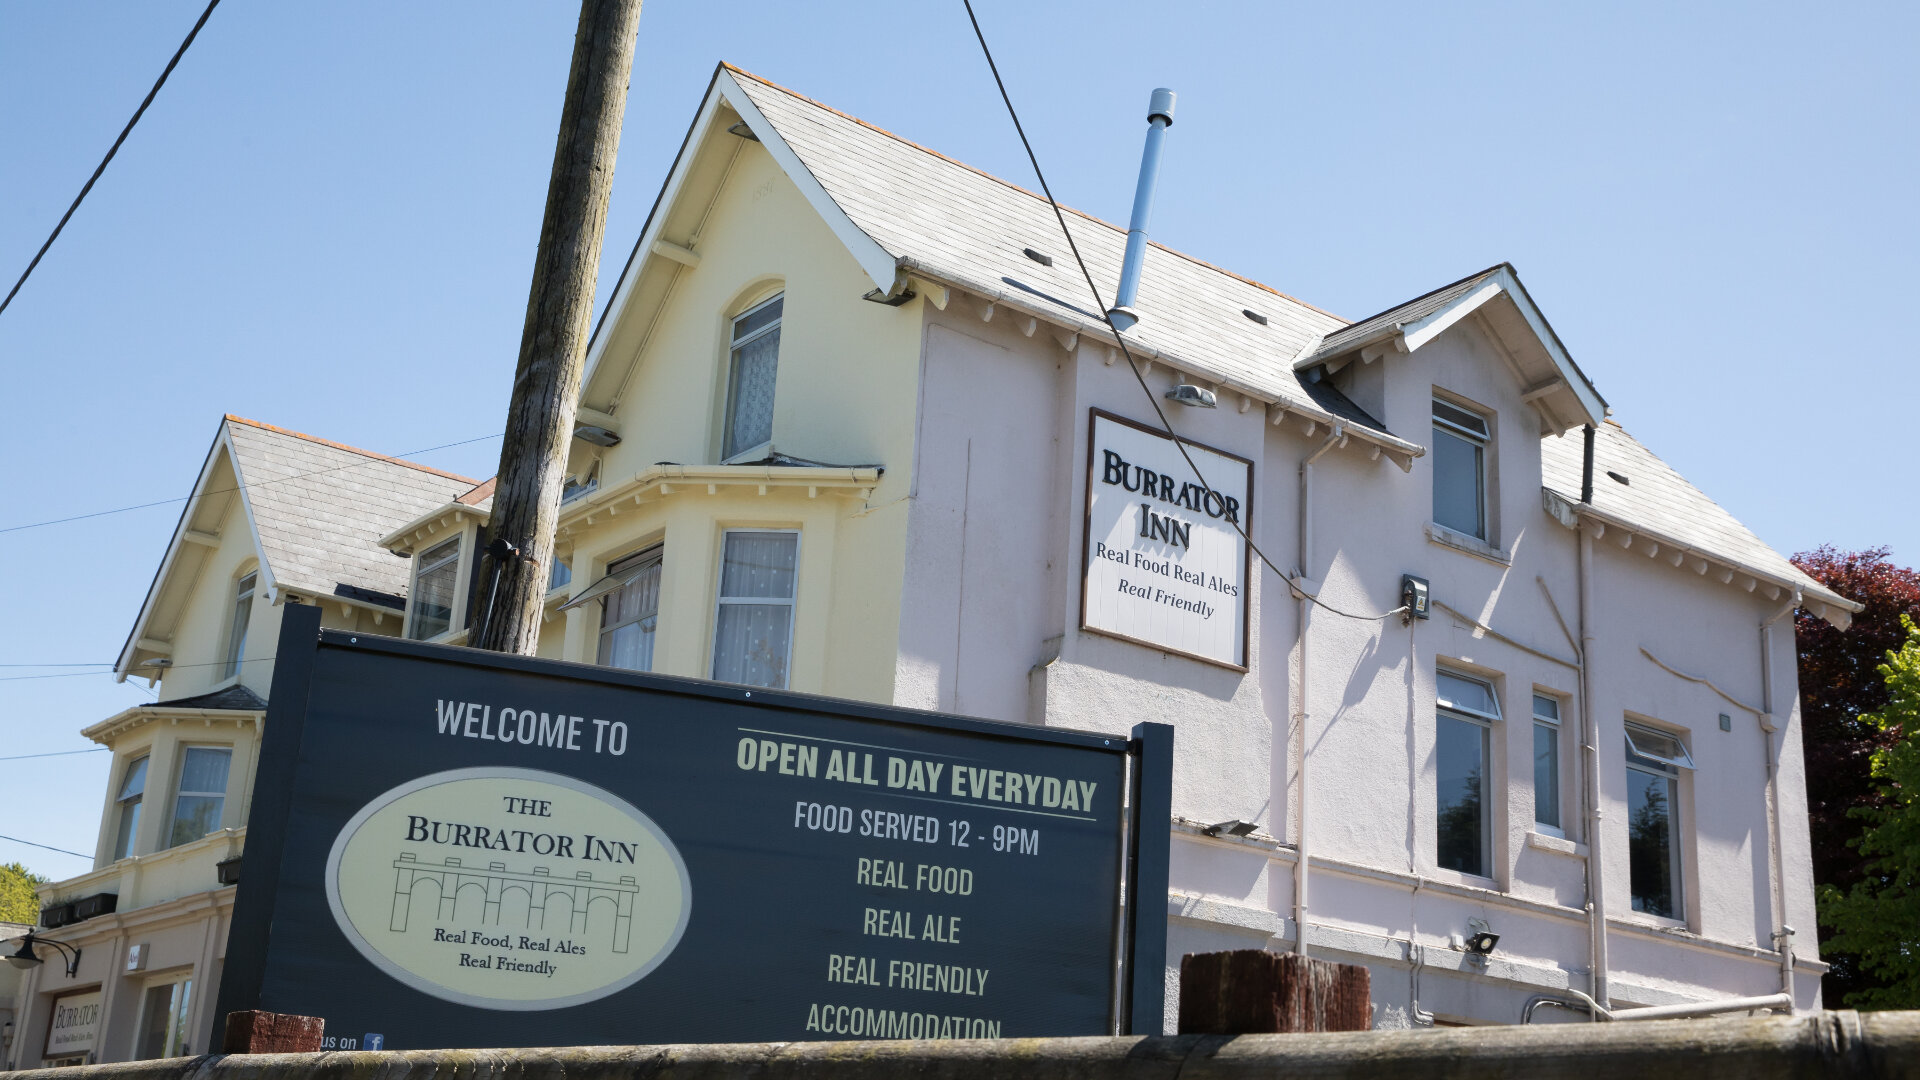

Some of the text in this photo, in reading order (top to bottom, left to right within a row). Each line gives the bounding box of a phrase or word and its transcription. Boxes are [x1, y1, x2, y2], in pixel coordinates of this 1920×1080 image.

[1102, 449, 1240, 524] BURRATOR
[1140, 503, 1191, 551] INN
[1097, 541, 1238, 597] Real Food Real Ales
[1118, 578, 1215, 620] Real Friendly
[437, 699, 628, 756] WELCOME TO
[736, 737, 1098, 812] OPEN ALL DAY EVERYDAY
[503, 796, 552, 818] THE
[405, 815, 639, 865] BURRATOR INN
[794, 801, 853, 834] FOOD
[860, 809, 940, 844] SERVED
[948, 820, 970, 848] 12
[992, 825, 1039, 856] 9PM
[857, 858, 974, 896] REAL FOOD
[434, 928, 587, 956] Real Food, Real Ales
[864, 908, 961, 944] REAL ALE
[459, 953, 558, 978] Real Friendly
[828, 954, 989, 996] REAL FRIENDLY
[339, 1037, 356, 1049] on
[806, 1003, 1001, 1041] ACCOMMODATION
